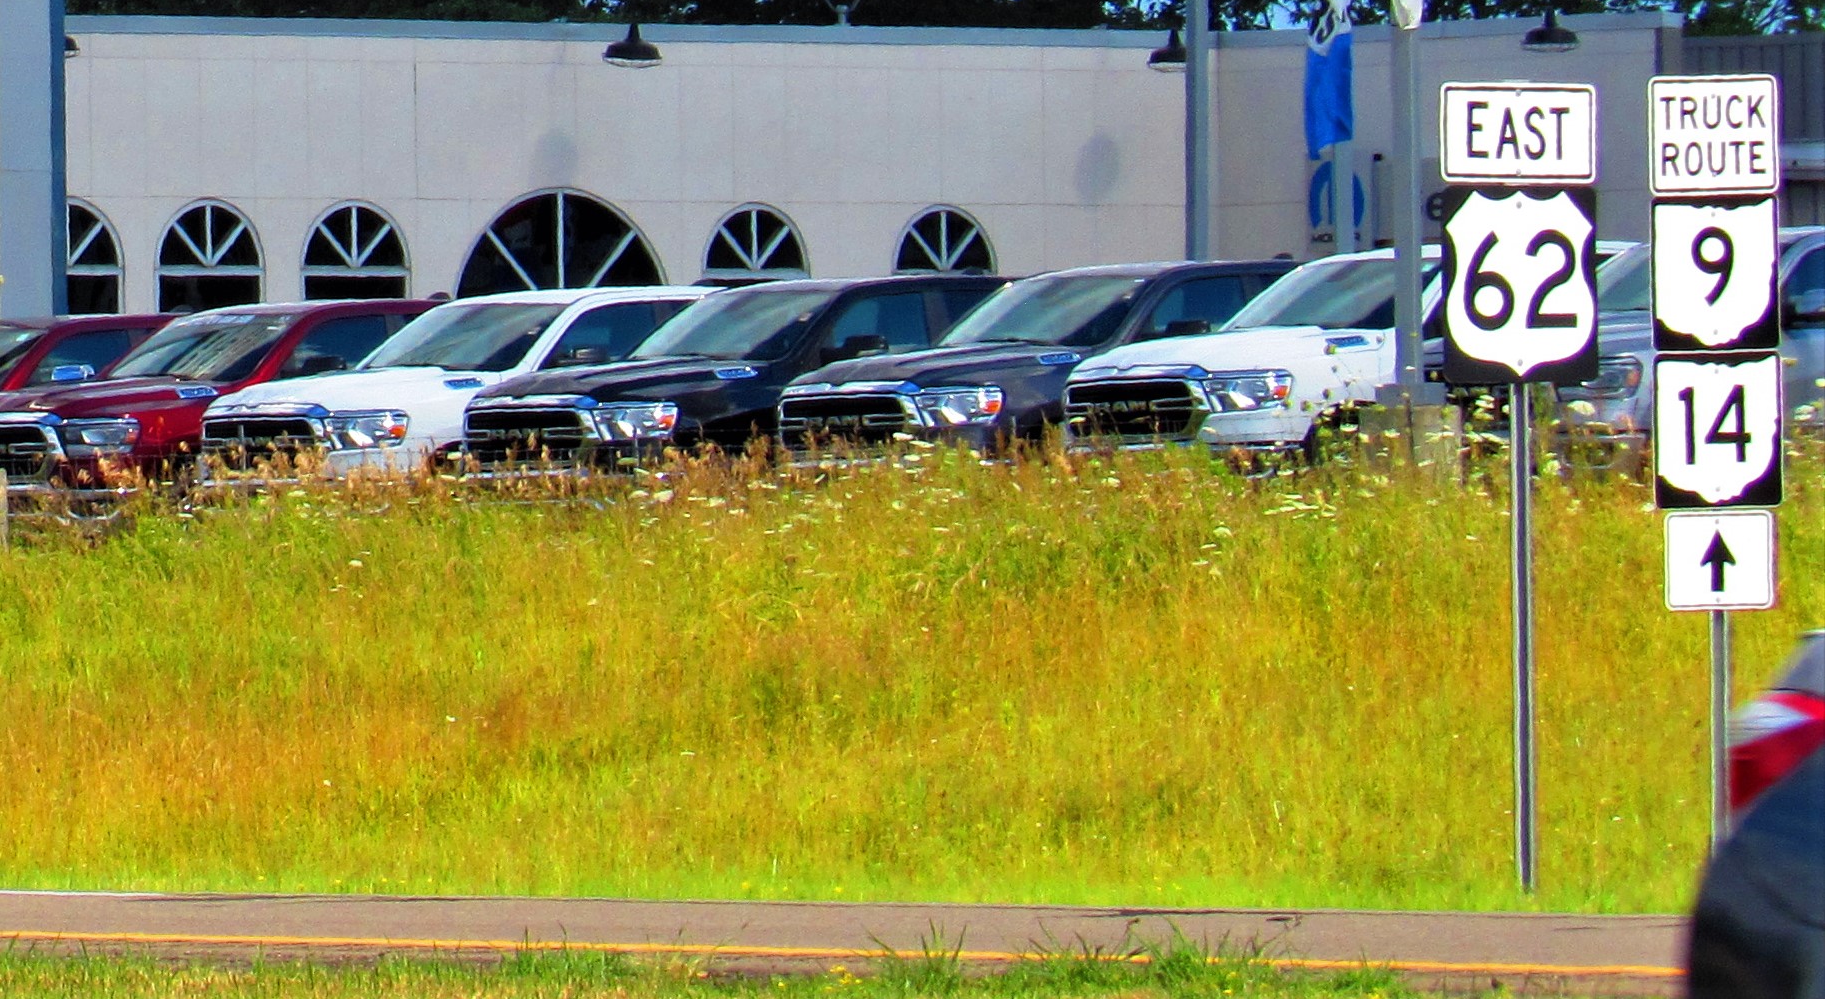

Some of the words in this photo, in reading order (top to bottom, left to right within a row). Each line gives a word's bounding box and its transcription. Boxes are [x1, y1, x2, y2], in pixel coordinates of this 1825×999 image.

[1465, 101, 1570, 160] EAST
[1660, 94, 1766, 130] TRUCK
[1661, 141, 1766, 177] ROUTE
[1463, 229, 1578, 331] 62
[1691, 226, 1735, 307] 9
[1678, 384, 1752, 466] 14
